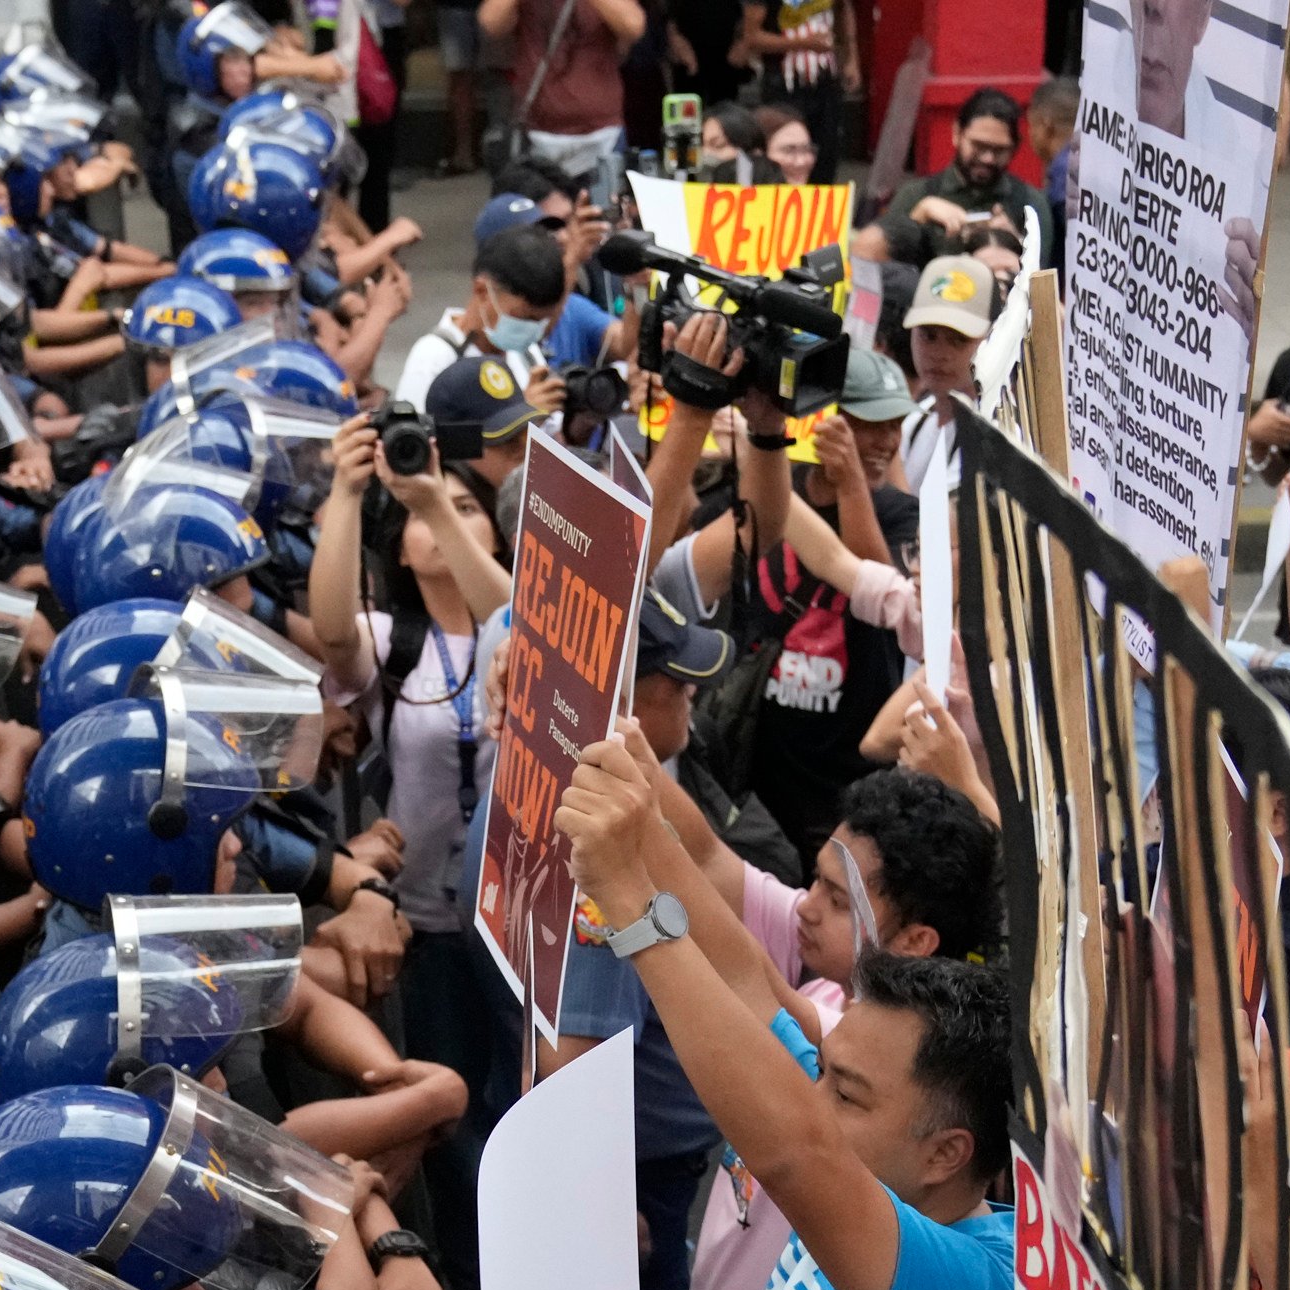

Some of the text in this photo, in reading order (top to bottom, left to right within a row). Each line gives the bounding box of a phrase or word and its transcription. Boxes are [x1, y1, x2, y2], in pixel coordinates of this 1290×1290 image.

[695, 183, 848, 274] REJOIN
[1188, 165, 1227, 222] ROA
[1143, 345, 1228, 419] HUMANITY
[1149, 390, 1207, 450] torture,
[1126, 446, 1197, 520] detention,
[528, 490, 593, 558] #ENDIMPUNITY
[515, 529, 623, 694] REJOIN
[506, 621, 544, 734] ICC
[779, 649, 844, 691] END
[551, 687, 580, 728] Duterte
